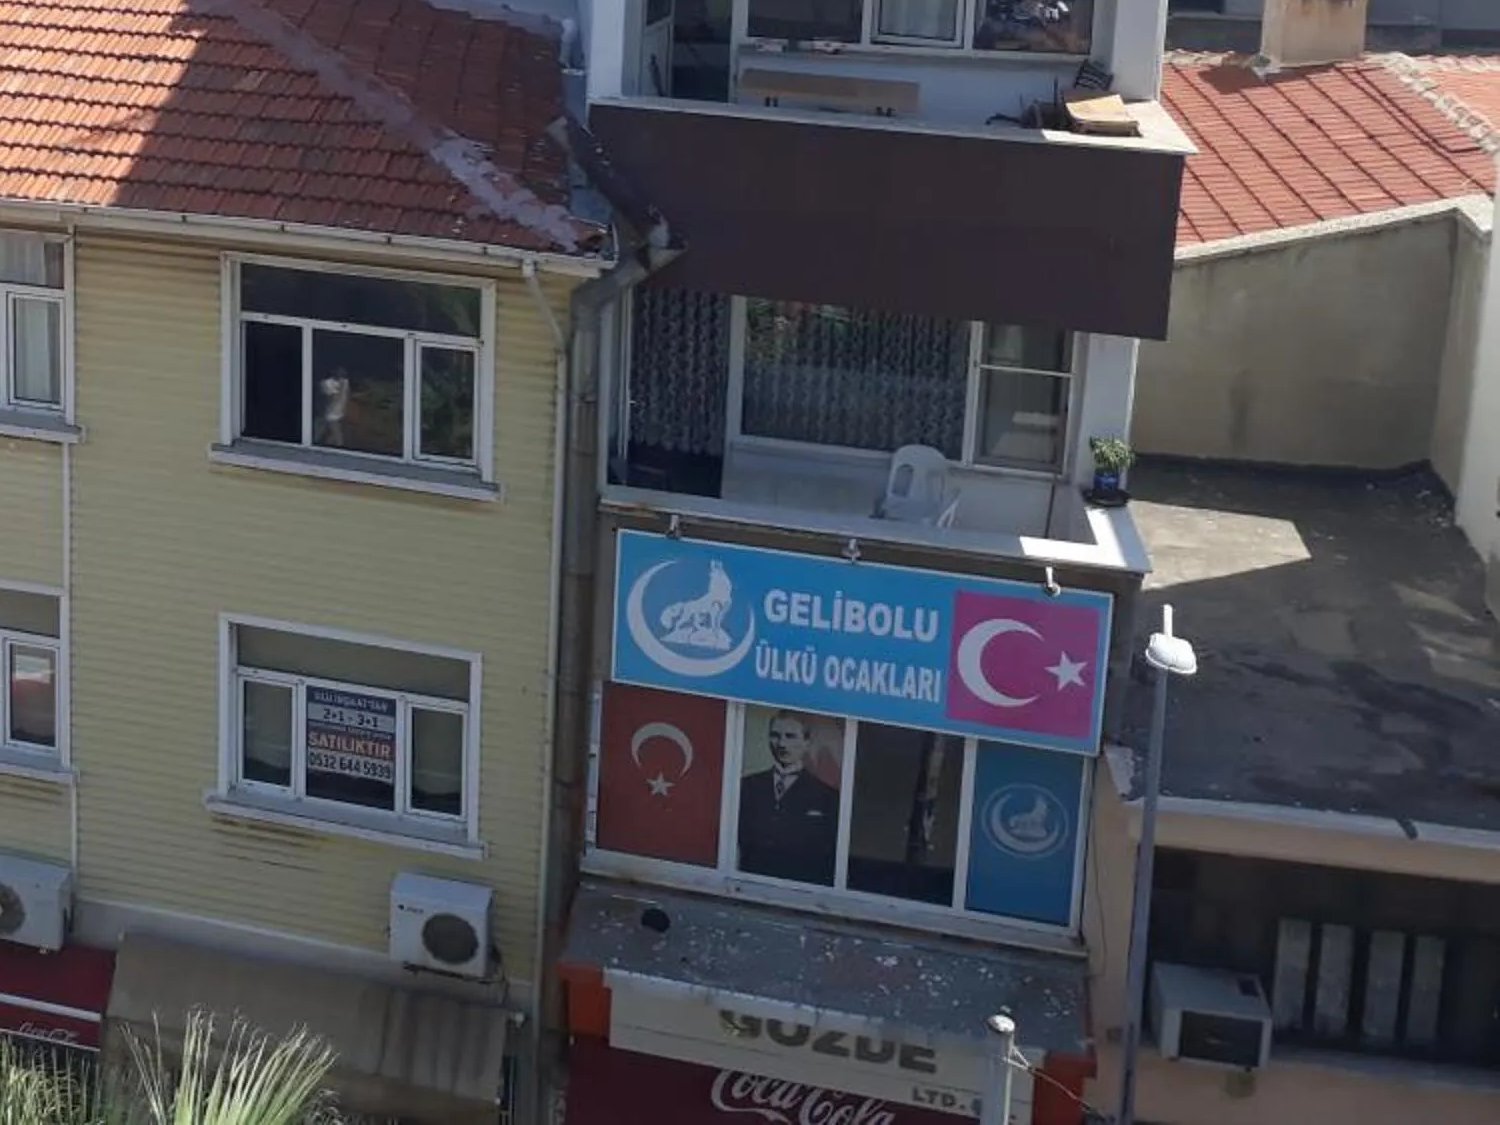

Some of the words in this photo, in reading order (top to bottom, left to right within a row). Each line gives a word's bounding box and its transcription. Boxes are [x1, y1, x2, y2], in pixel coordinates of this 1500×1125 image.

[764, 587, 939, 643] GELİBOLU
[755, 639, 817, 686] ÜLKÜ
[824, 654, 941, 703] OCAKLARI
